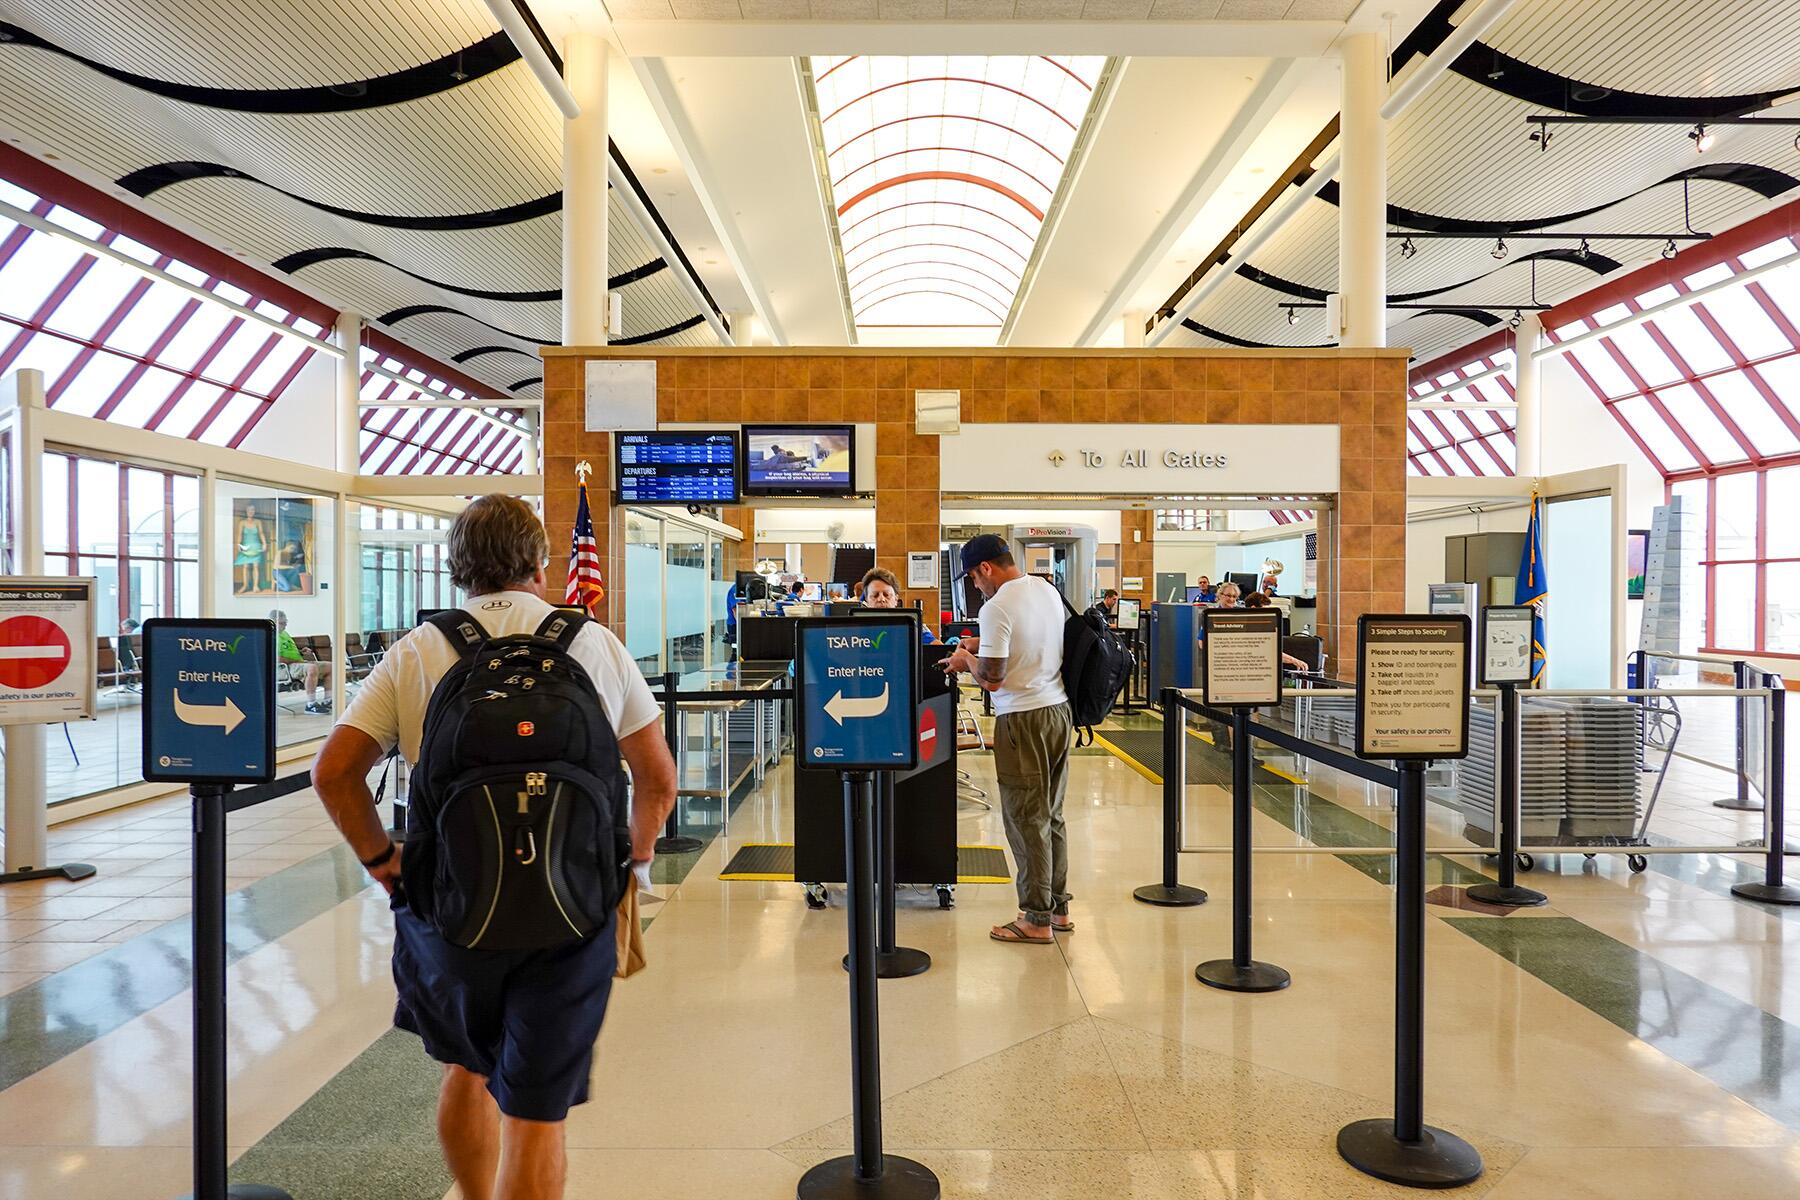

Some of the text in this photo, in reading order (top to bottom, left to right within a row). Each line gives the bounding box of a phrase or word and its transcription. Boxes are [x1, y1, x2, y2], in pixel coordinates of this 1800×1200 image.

[623, 435, 648, 443] ARRIVALS
[1080, 449, 1229, 468] To All Gates
[624, 467, 656, 475] DEPARTURES
[1036, 528, 1066, 536] ProVision
[43, 591, 63, 600] Only
[1376, 628, 1397, 636] Simple
[1397, 628, 1414, 636] Steps
[1422, 628, 1448, 636] Security
[178, 638, 227, 652] TSA Pre
[826, 636, 871, 648] TSA Pre
[178, 670, 240, 683] Enter Here
[827, 666, 884, 678] Enter Here
